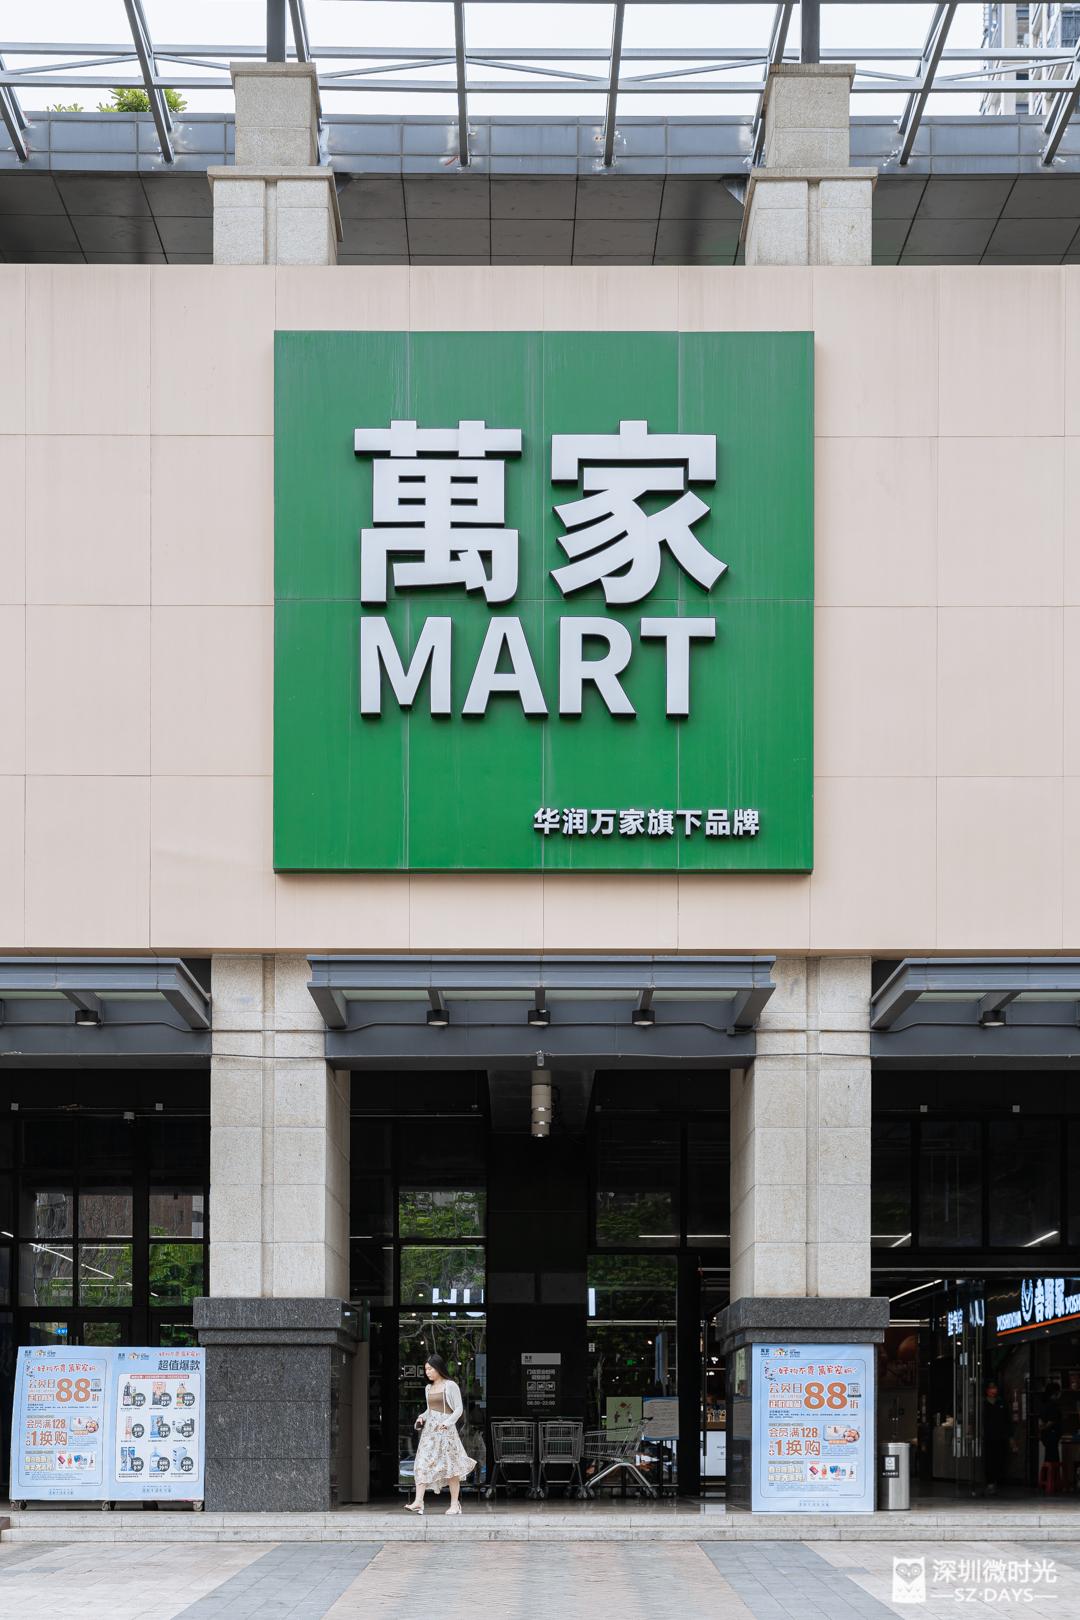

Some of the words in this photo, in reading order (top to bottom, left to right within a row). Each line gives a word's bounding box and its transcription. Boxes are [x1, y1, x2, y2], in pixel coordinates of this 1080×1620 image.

[353, 420, 728, 604] 萬家
[360, 616, 717, 719] MART
[533, 807, 760, 836] 华润万家旗下品牌
[158, 1359, 200, 1371] 超值爆款
[56, 1378, 91, 1402] 88
[804, 1381, 848, 1409] 88
[768, 1427, 818, 1438] 会员满128
